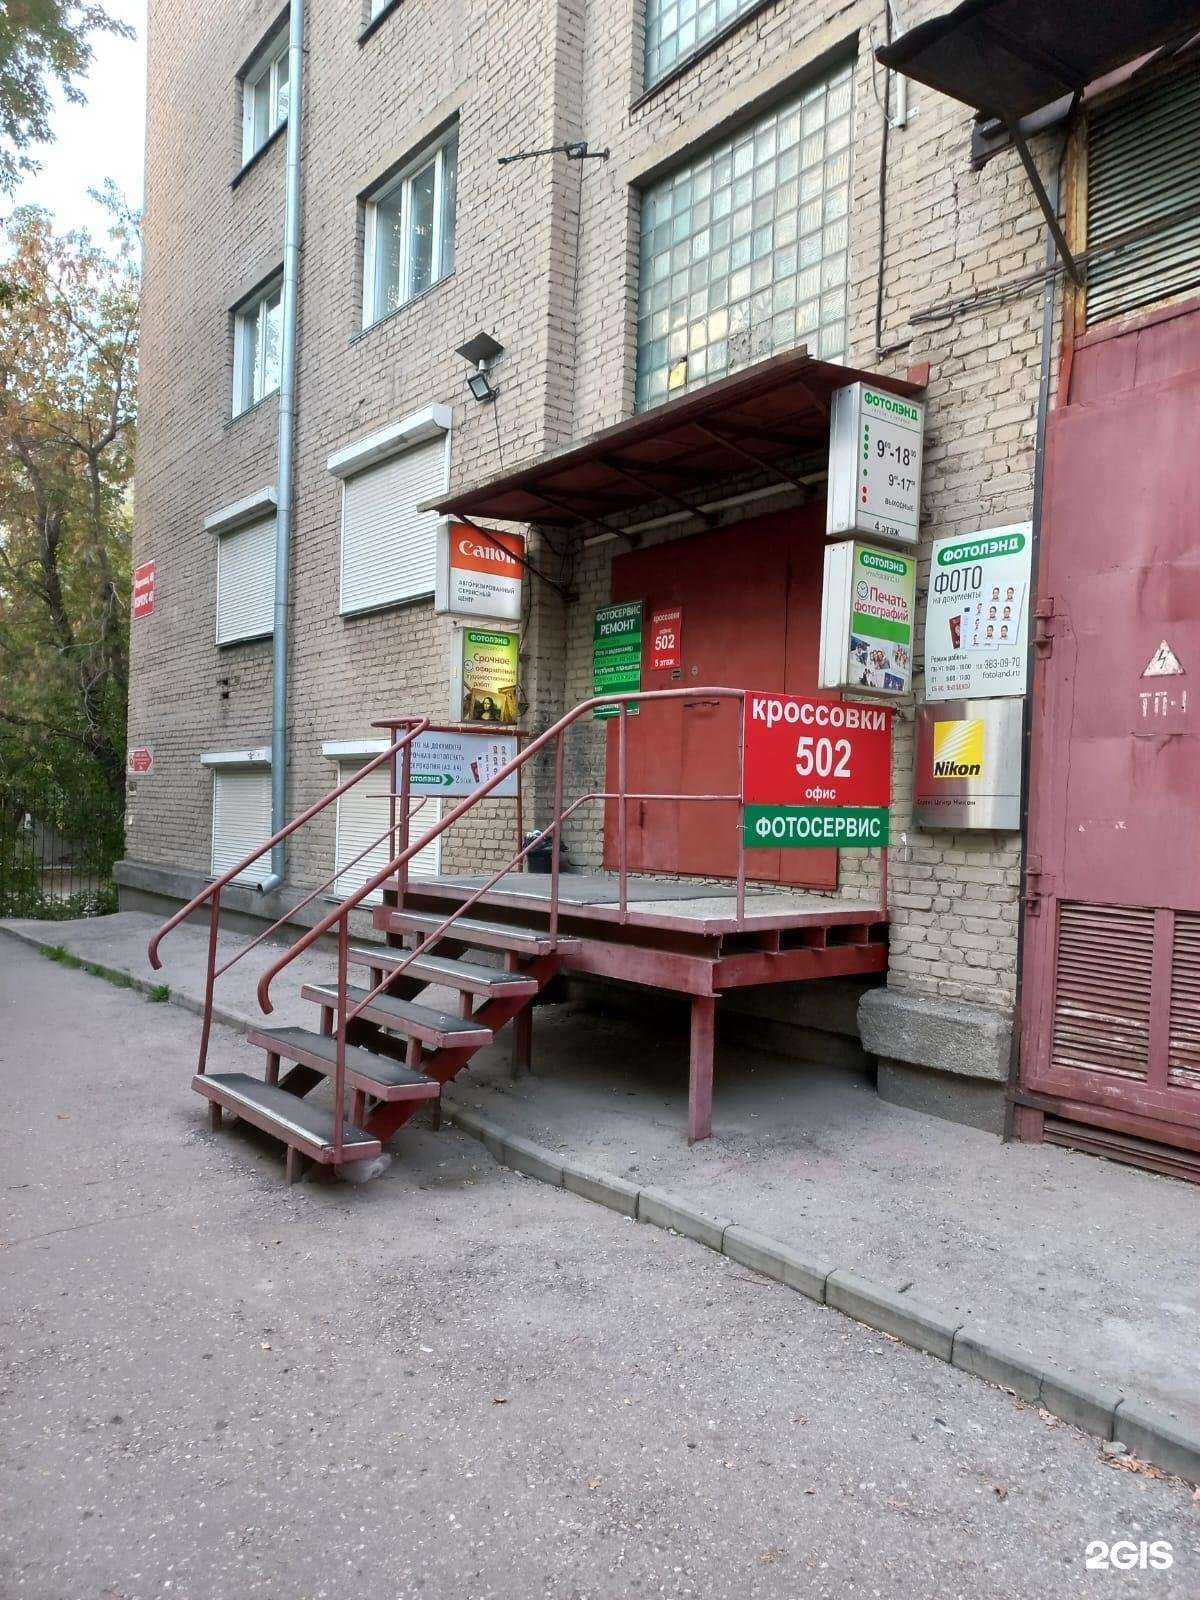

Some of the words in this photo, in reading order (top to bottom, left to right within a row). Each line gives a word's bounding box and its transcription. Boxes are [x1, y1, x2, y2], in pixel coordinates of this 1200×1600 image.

[864, 391, 918, 421] ФОТОЛЭНД
[874, 521, 880, 530] 4
[943, 538, 1019, 562] ФОТОЛЭНД
[863, 554, 904, 573] ФОТОЛЭНД
[934, 565, 983, 594] ФОТО
[457, 587, 491, 598] СЕРВИСНЫЙ
[457, 595, 474, 603] ЦЕНТР
[870, 586, 907, 608] Печать
[596, 605, 641, 622] ФОТОСЕРВИС
[854, 600, 909, 621] фотографий
[600, 618, 635, 636] РЕМОНТ
[470, 634, 508, 645] ФОТОЛЭНД
[655, 634, 675, 651] 502
[473, 652, 510, 665] Срочное
[655, 659, 659, 668] 5
[660, 658, 675, 667] этаж
[984, 656, 1021, 669] 383-09-70
[982, 669, 1021, 679] fotoland.ru
[752, 698, 886, 731] кроссовки
[796, 736, 852, 778] 502
[934, 761, 981, 776] Nikon
[409, 775, 441, 783] ОТОЛЭНД
[805, 785, 836, 802] офис
[755, 816, 881, 838] ФОТОСЕРВИС
